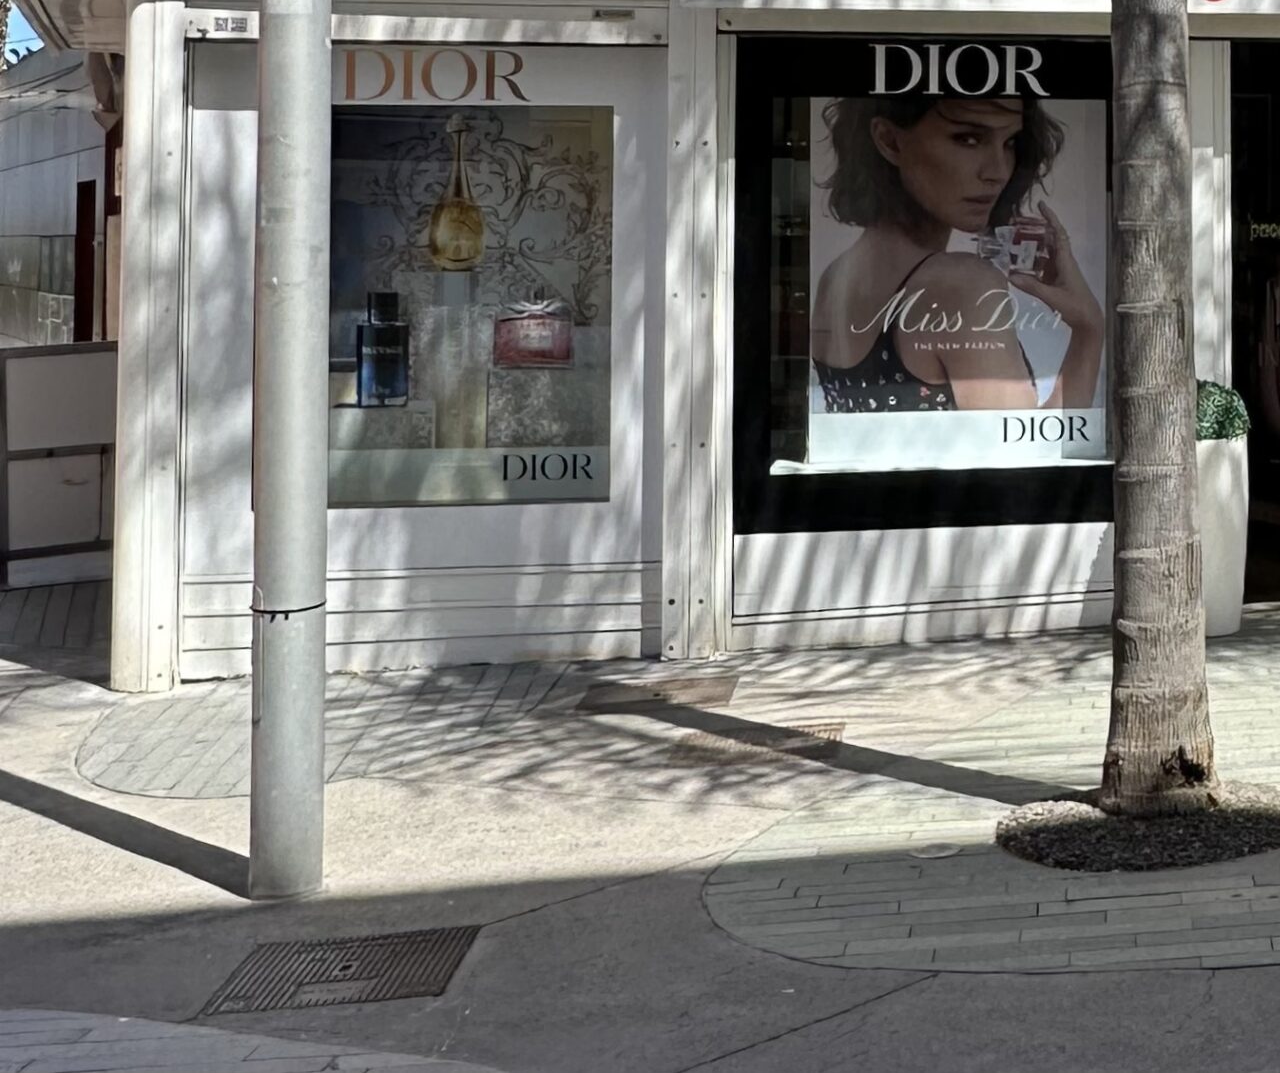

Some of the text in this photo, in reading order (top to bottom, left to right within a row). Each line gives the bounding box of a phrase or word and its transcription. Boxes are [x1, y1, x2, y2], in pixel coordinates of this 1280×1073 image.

[341, 49, 532, 102] DIOR
[868, 43, 1051, 97] DIOR
[850, 288, 963, 334] Miss
[1002, 415, 1091, 443] DIOR
[501, 452, 595, 482] DIOR
